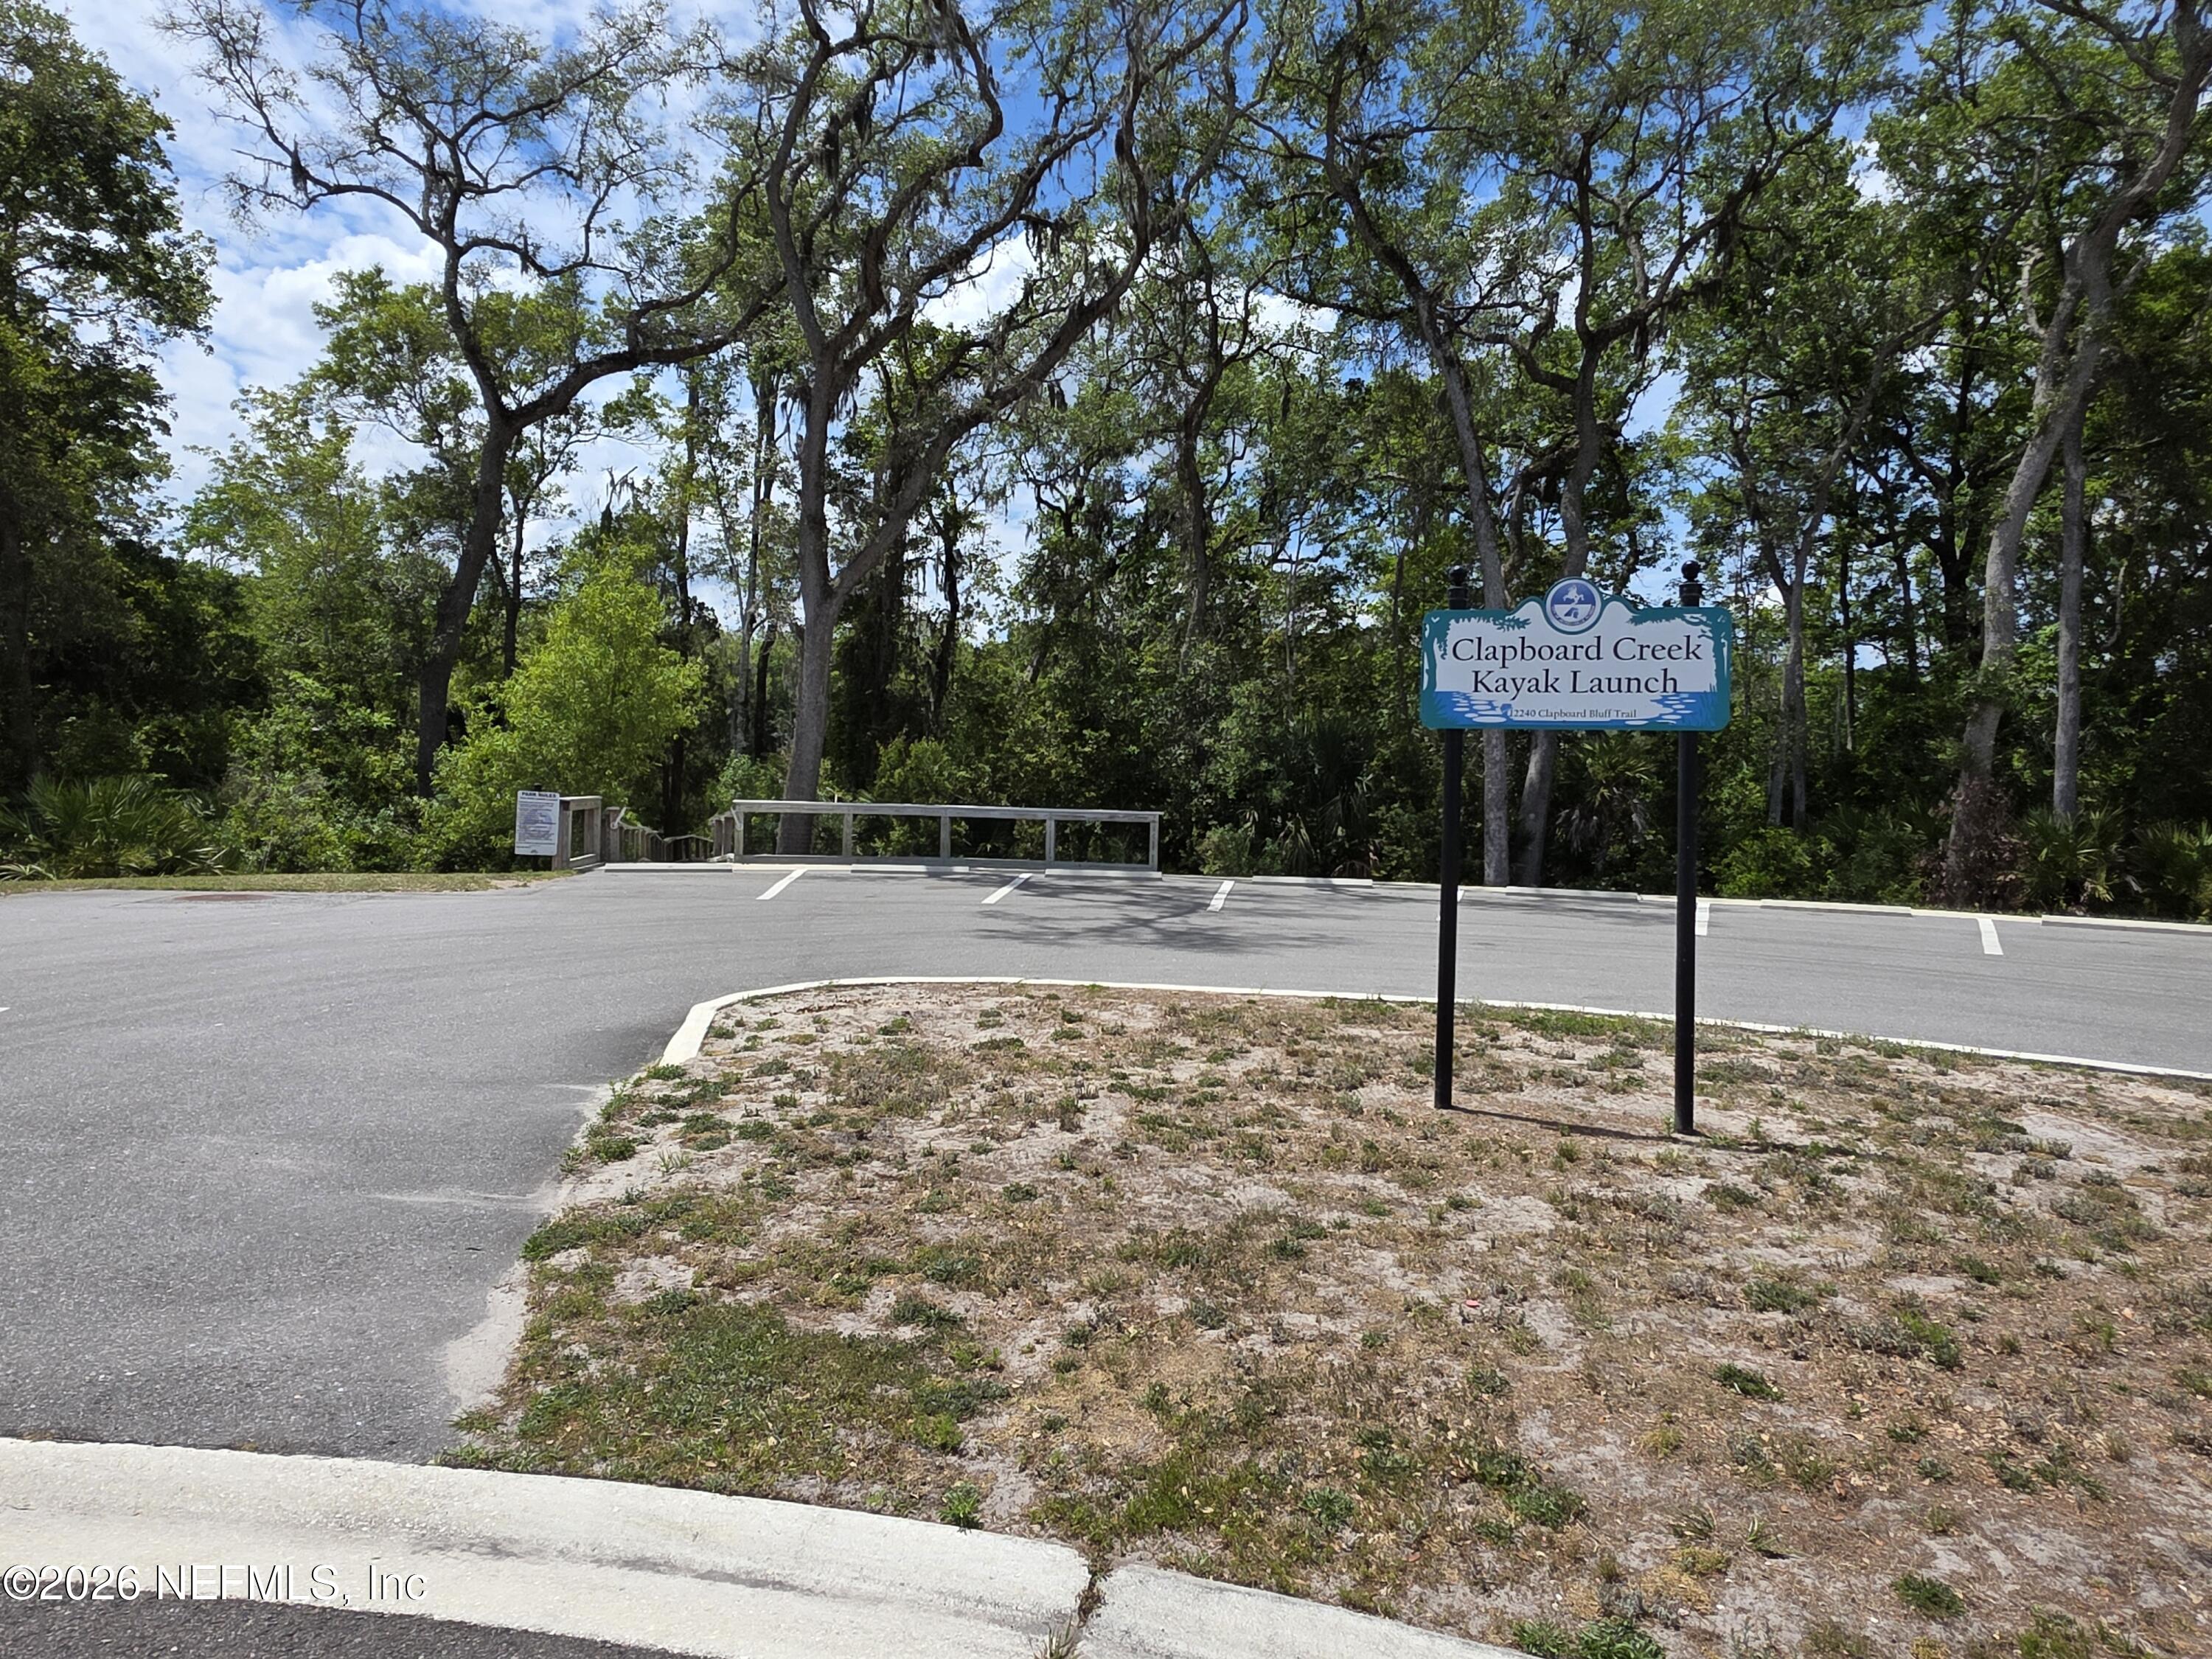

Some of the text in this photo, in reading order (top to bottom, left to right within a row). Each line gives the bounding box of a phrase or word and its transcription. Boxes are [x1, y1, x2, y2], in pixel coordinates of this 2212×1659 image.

[1452, 635, 1703, 669] Clapboard Creek
[1472, 668, 1678, 700] Kayak Launch
[1509, 709, 1637, 720] 12240 Clapboard Bluff Trail
